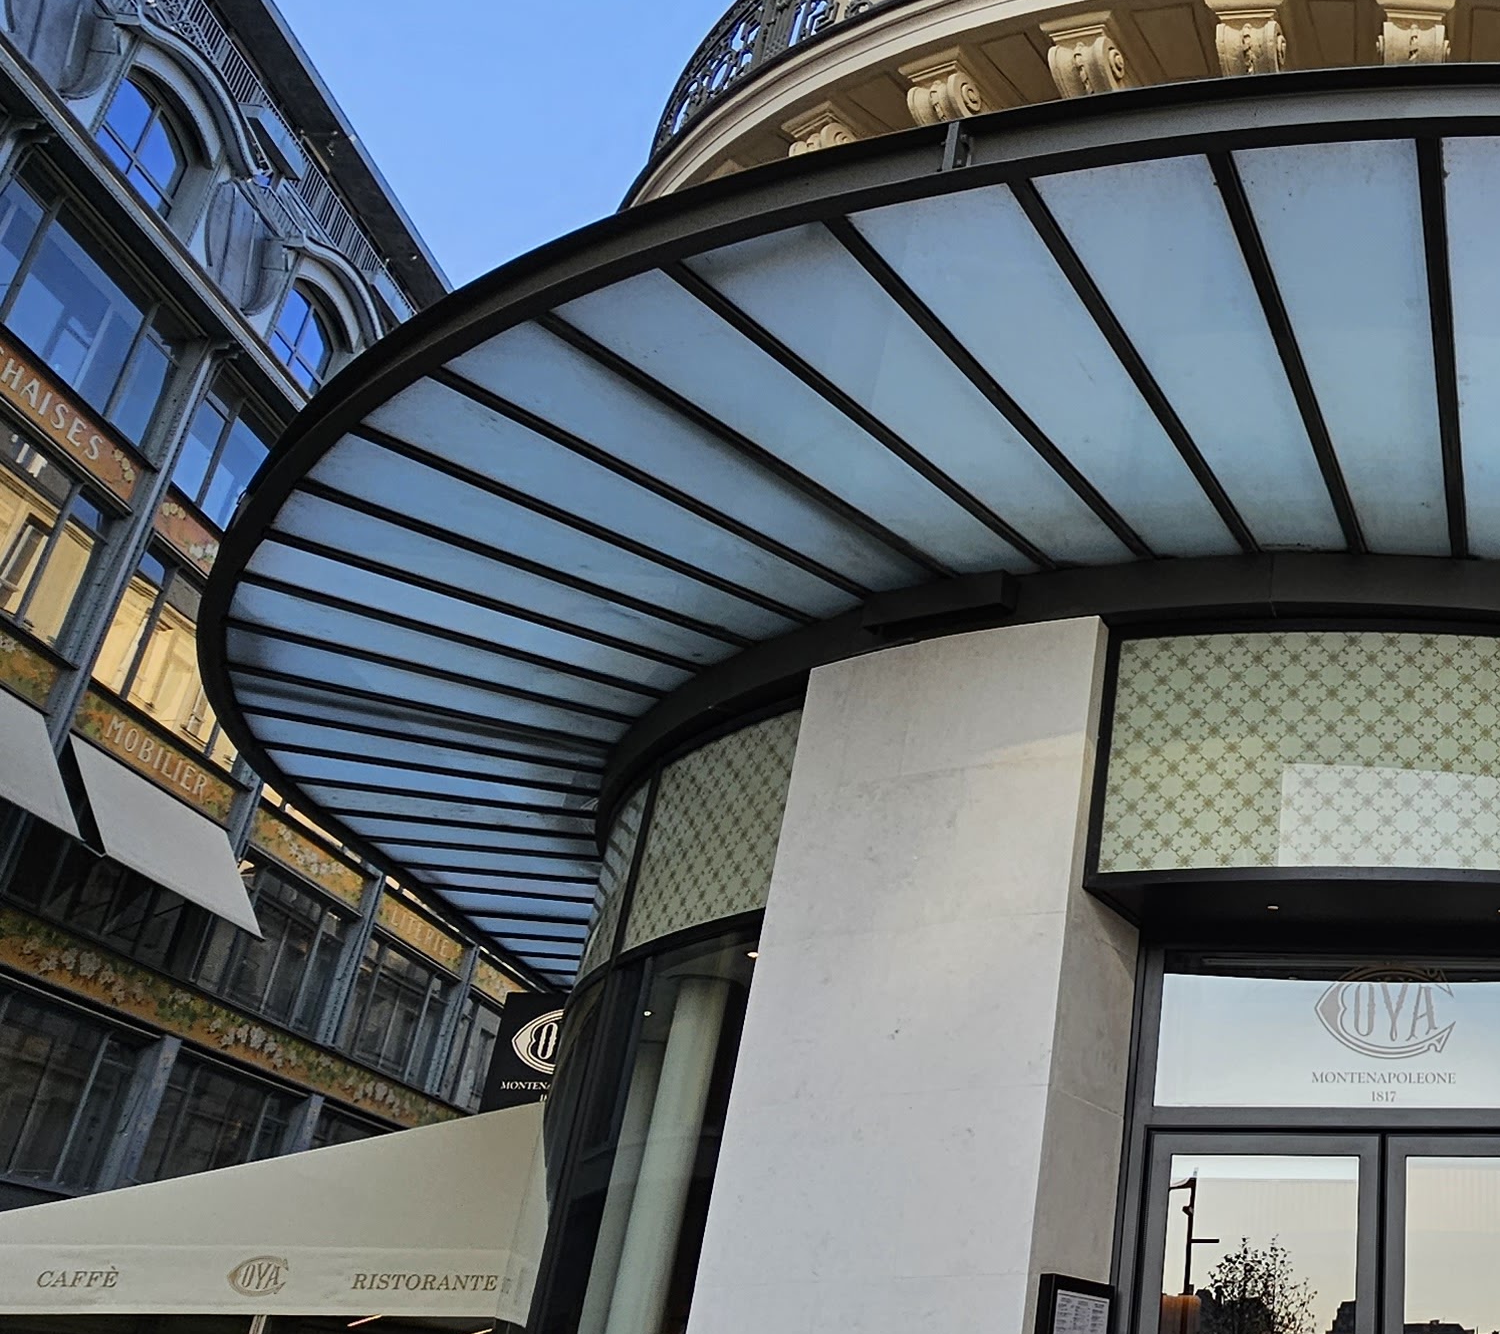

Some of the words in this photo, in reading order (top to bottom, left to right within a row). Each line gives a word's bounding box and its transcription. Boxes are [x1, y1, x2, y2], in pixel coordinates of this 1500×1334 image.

[0, 347, 104, 460] HAISES
[105, 715, 207, 798] MOBILIER
[390, 907, 450, 957] LITERIE
[1311, 1071, 1457, 1085] MONTENAPOLEONE
[1371, 1090, 1397, 1102] 1817
[36, 1266, 119, 1288] CAFFÈ
[350, 1273, 499, 1292] RISTORANTE
